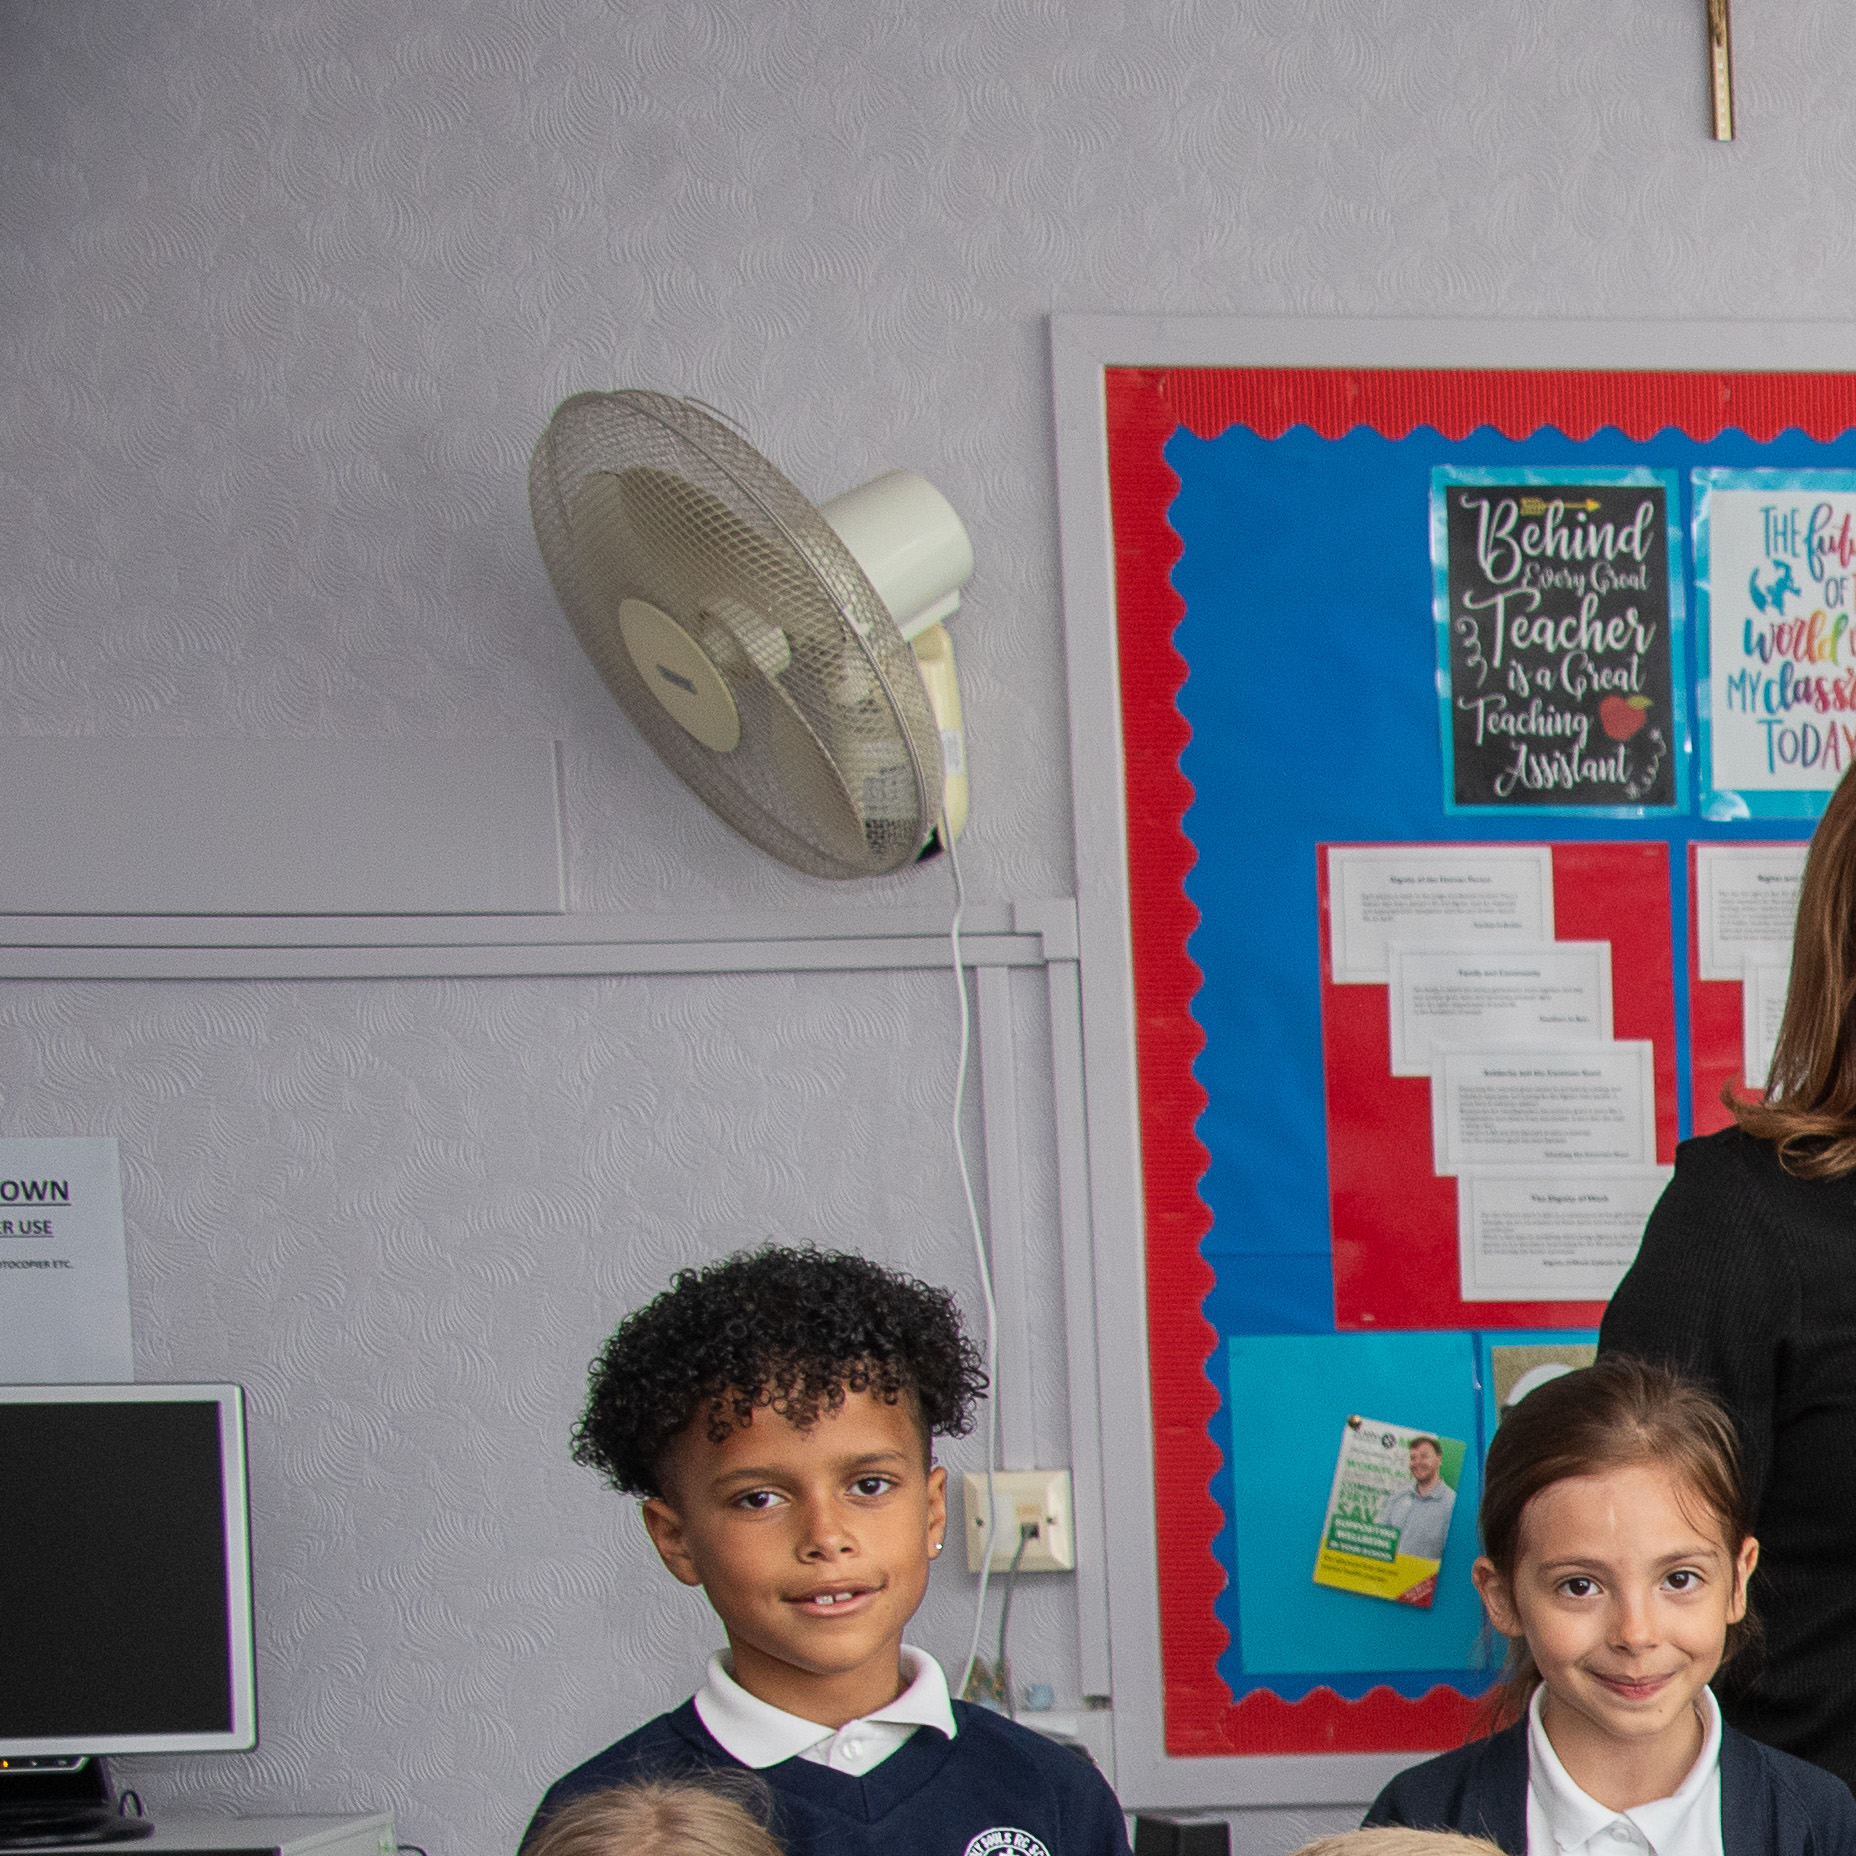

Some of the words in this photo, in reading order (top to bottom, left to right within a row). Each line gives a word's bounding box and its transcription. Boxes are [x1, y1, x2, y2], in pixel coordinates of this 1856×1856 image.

[1461, 498, 1654, 584] Behind
[1760, 506, 1801, 559] THE
[1521, 564, 1586, 597] Every
[1591, 562, 1649, 592] Great
[1825, 573, 1850, 608] OF
[1463, 588, 1657, 670] Teacher
[1745, 610, 1846, 665] world
[1507, 660, 1529, 699] is
[1536, 669, 1556, 693] a
[1560, 650, 1646, 703] Great
[1727, 671, 1762, 714] MY
[1457, 694, 1594, 748] Teaching
[1494, 742, 1632, 798] Assistant
[0, 1180, 70, 1201] OWN
[20, 1220, 54, 1235] USE
